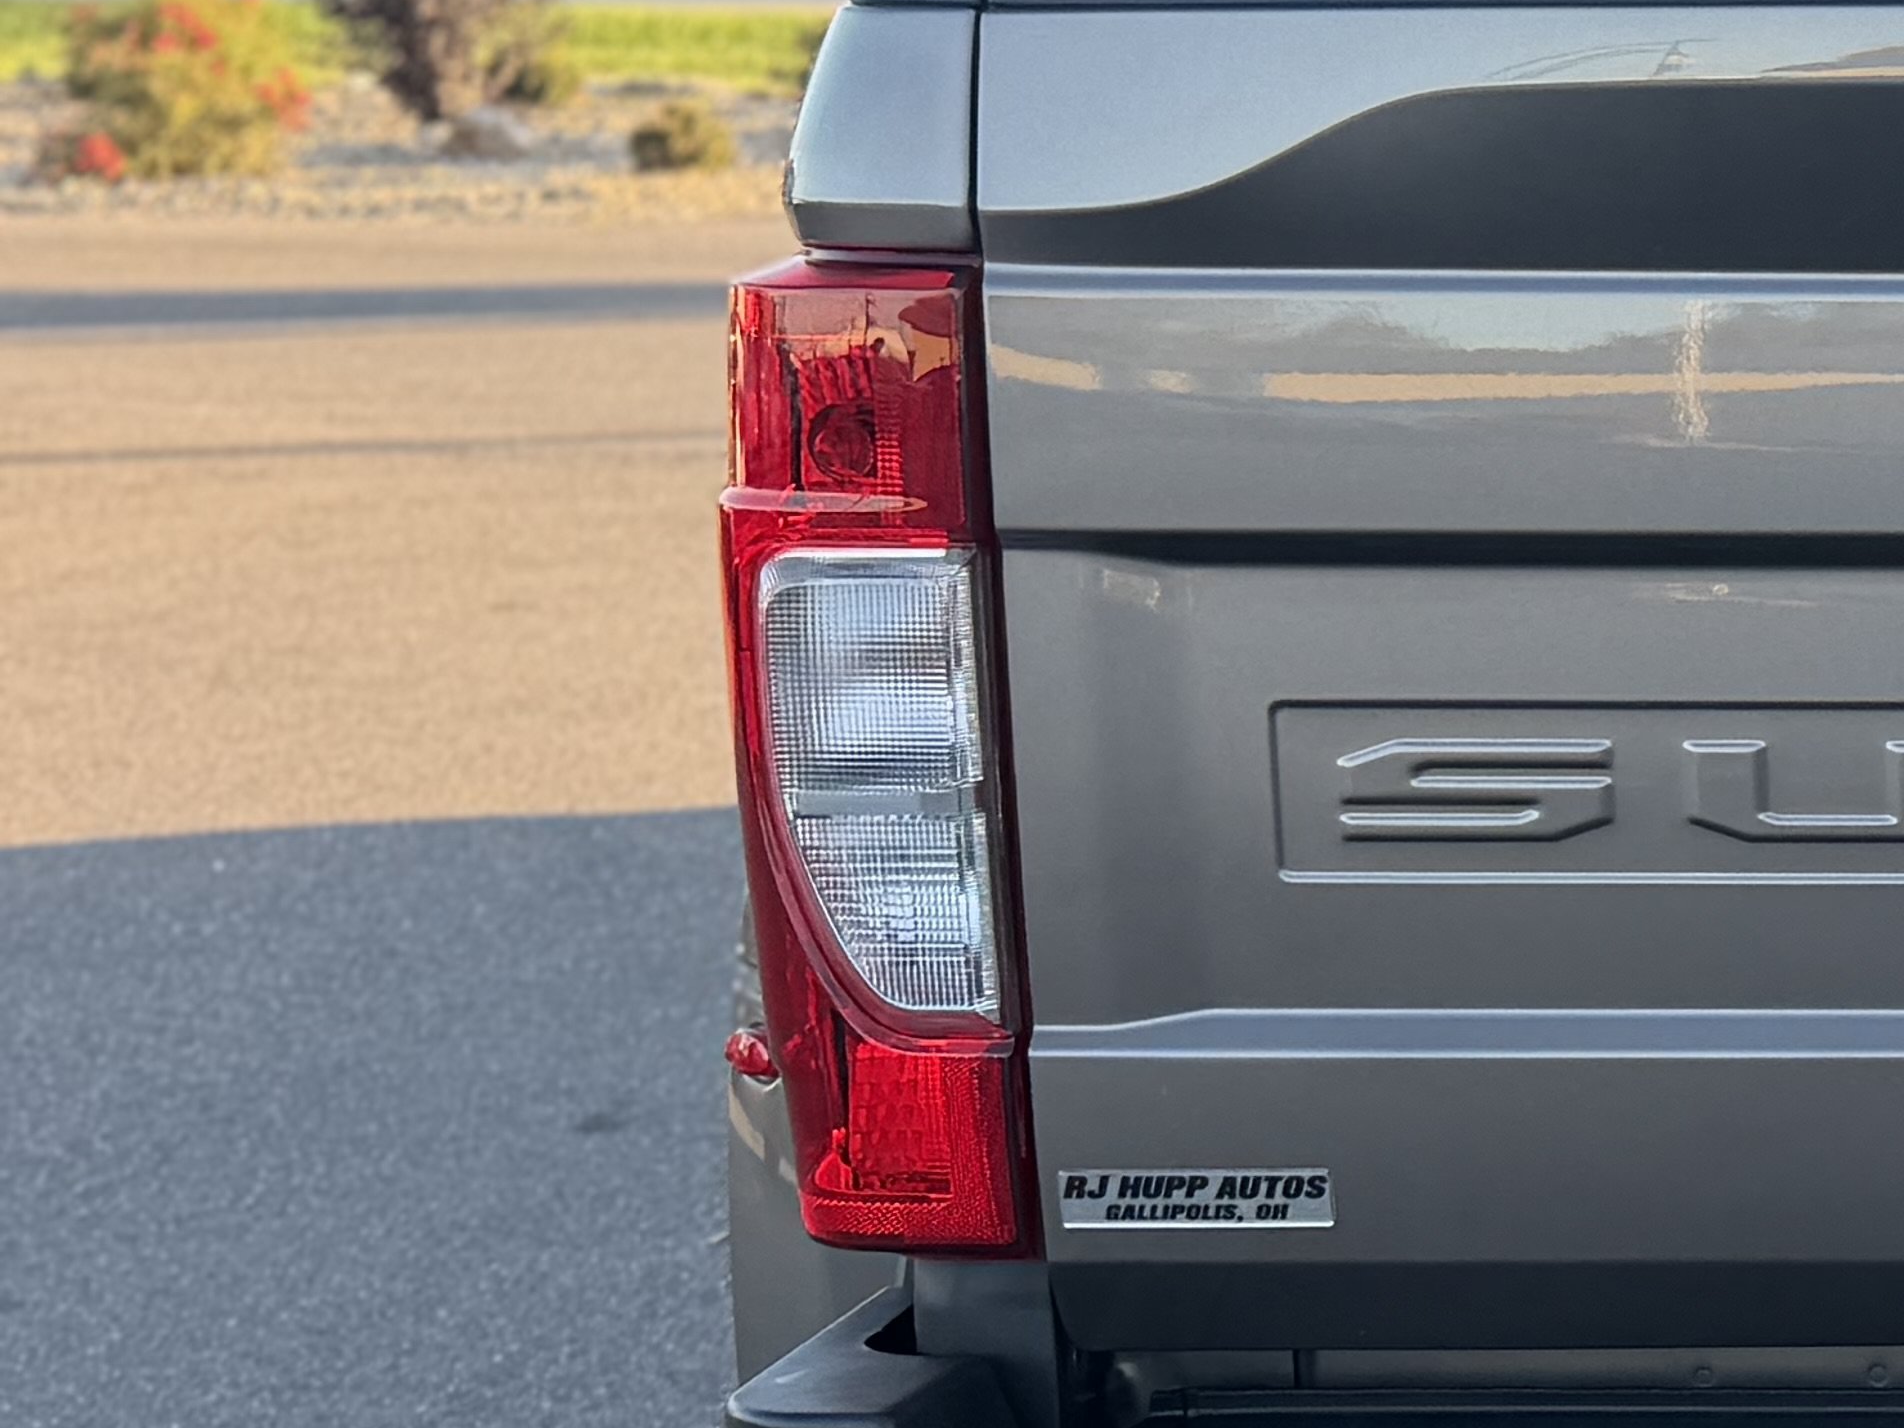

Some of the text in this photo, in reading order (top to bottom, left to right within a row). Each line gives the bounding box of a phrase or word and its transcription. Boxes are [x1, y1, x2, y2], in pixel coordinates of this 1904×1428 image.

[1063, 1175, 1328, 1200] RJ HUPP AUTOS
[1105, 1204, 1289, 1223] GALLIPOLIS, OH
